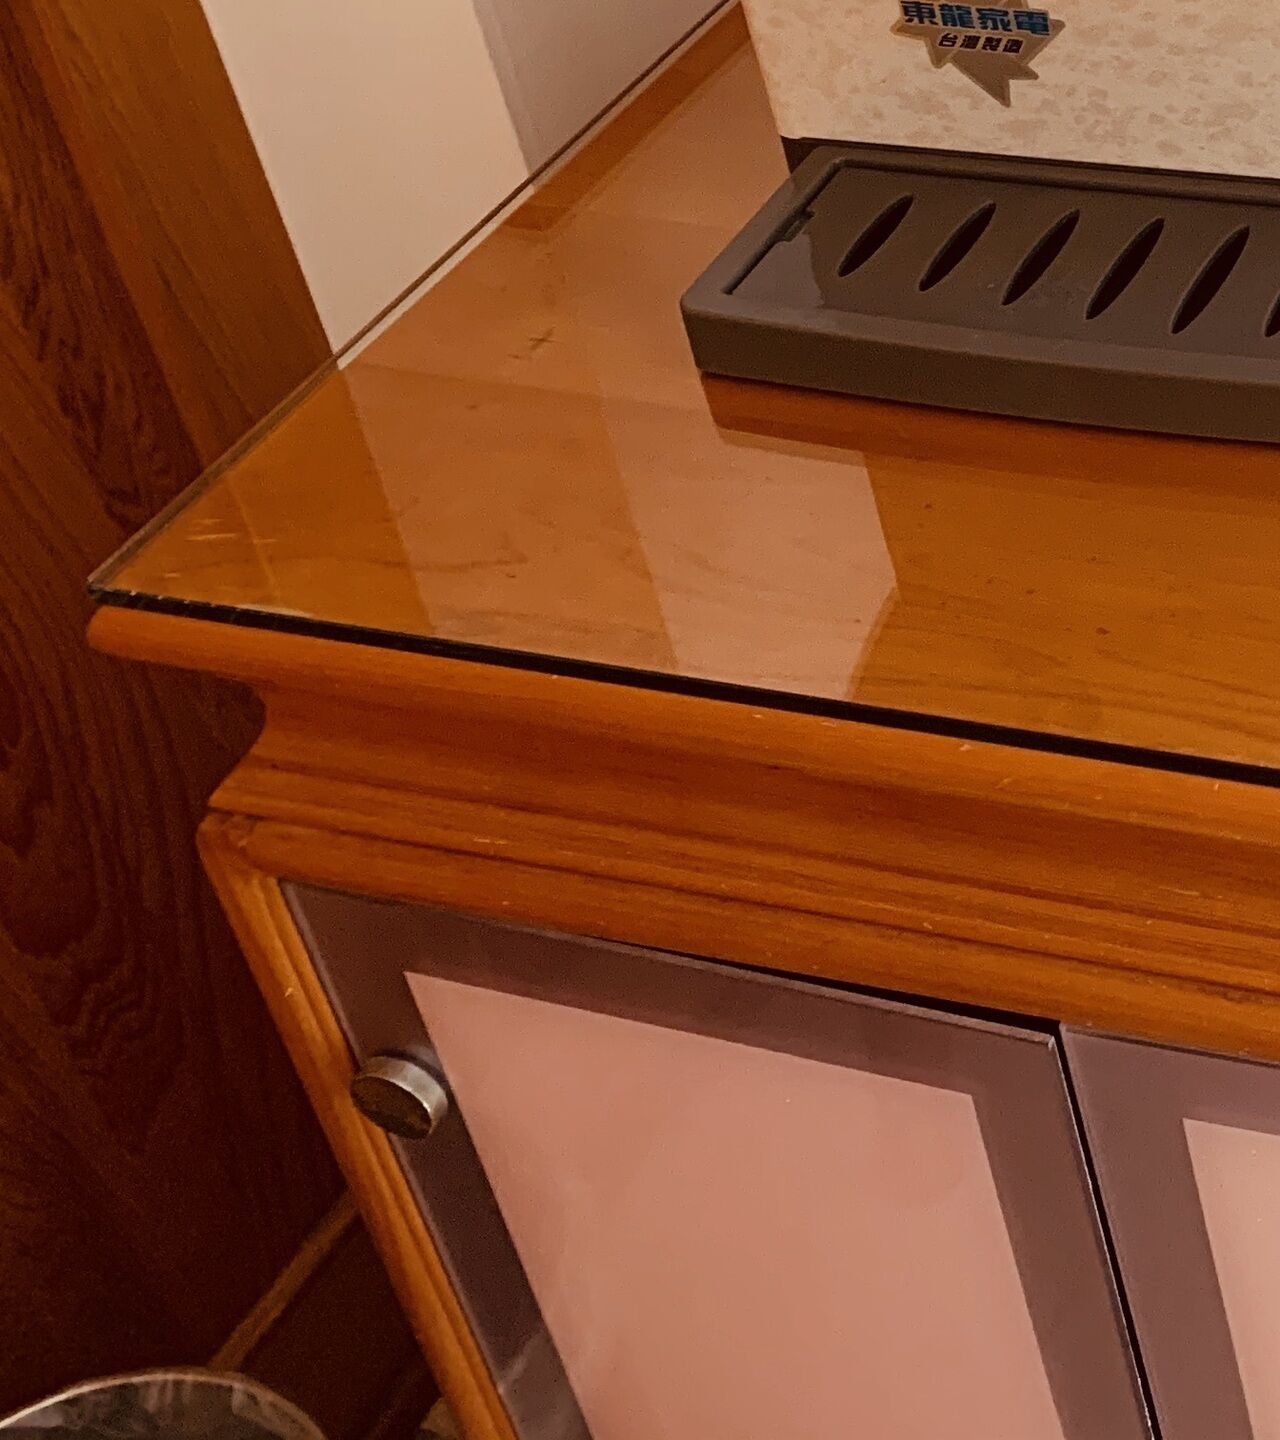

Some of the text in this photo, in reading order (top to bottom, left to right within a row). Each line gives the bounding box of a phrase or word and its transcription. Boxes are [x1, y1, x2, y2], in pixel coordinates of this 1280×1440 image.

[900, 0, 1050, 36] 東龍家電
[938, 32, 1024, 54] 台灣製造
